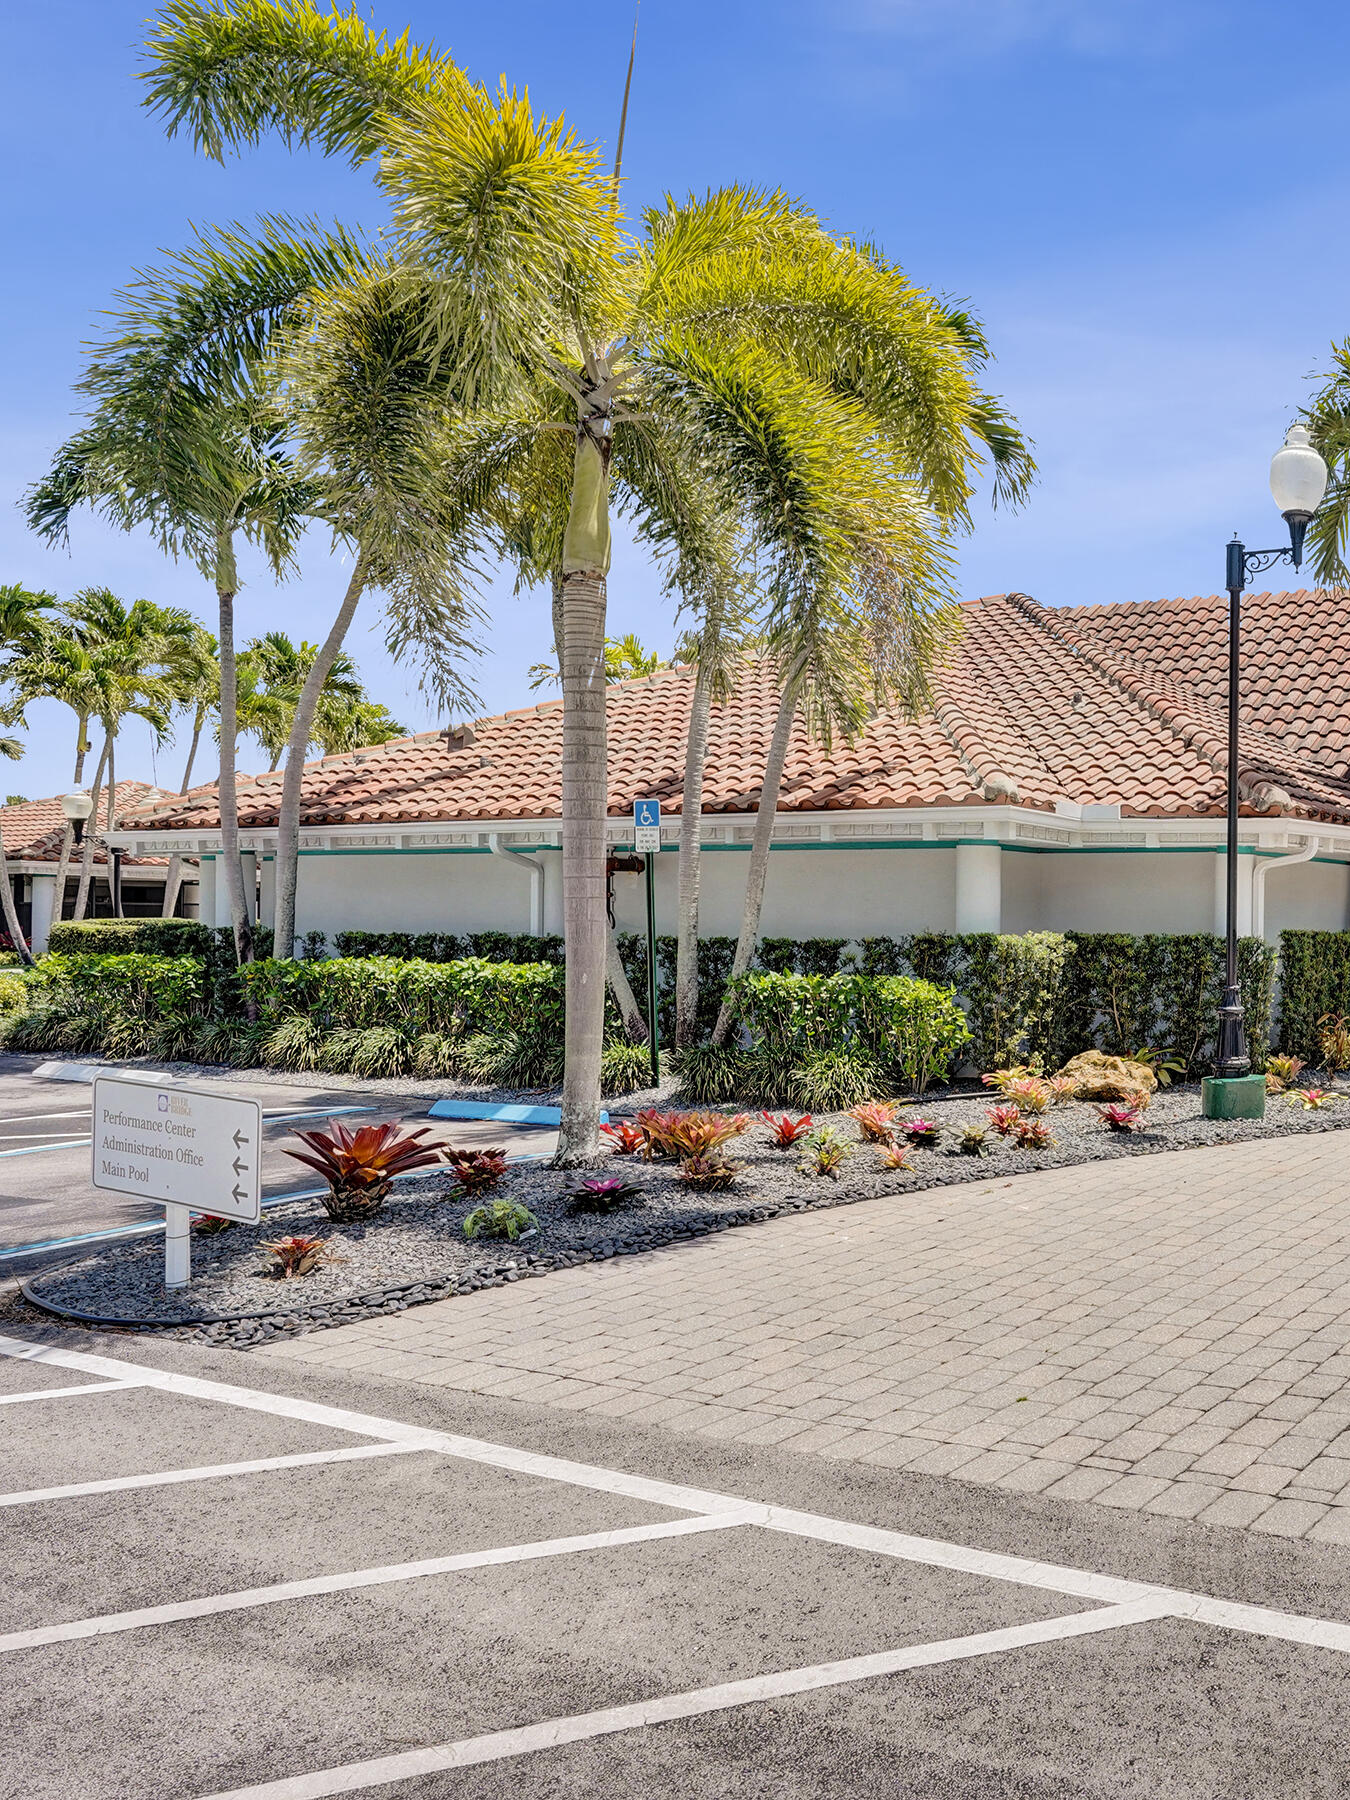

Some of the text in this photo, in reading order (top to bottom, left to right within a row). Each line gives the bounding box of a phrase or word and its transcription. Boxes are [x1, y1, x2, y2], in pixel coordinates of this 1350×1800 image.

[103, 1109, 196, 1138] Performance Center
[102, 1135, 204, 1167] Administration Office
[102, 1160, 149, 1182] Main Pool
